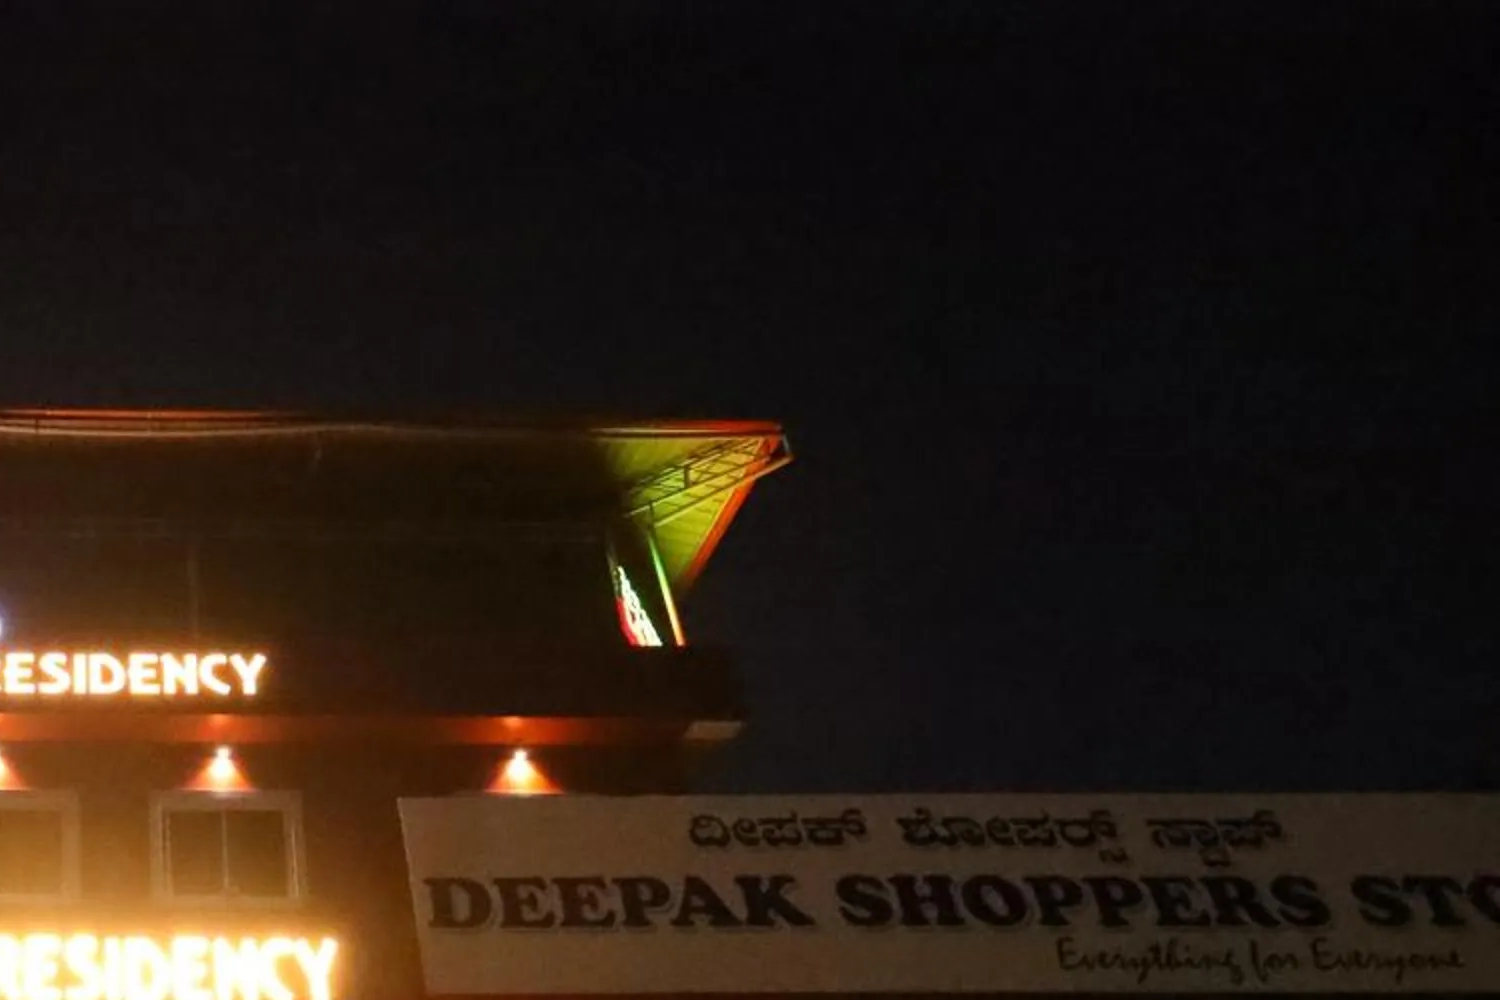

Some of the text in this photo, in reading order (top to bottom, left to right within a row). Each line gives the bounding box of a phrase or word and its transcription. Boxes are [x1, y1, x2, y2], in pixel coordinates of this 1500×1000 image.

[423, 875, 815, 930] DEEPAK
[836, 873, 1330, 930] SHOPPERS
[1056, 936, 1466, 985] Everything for Everyone
